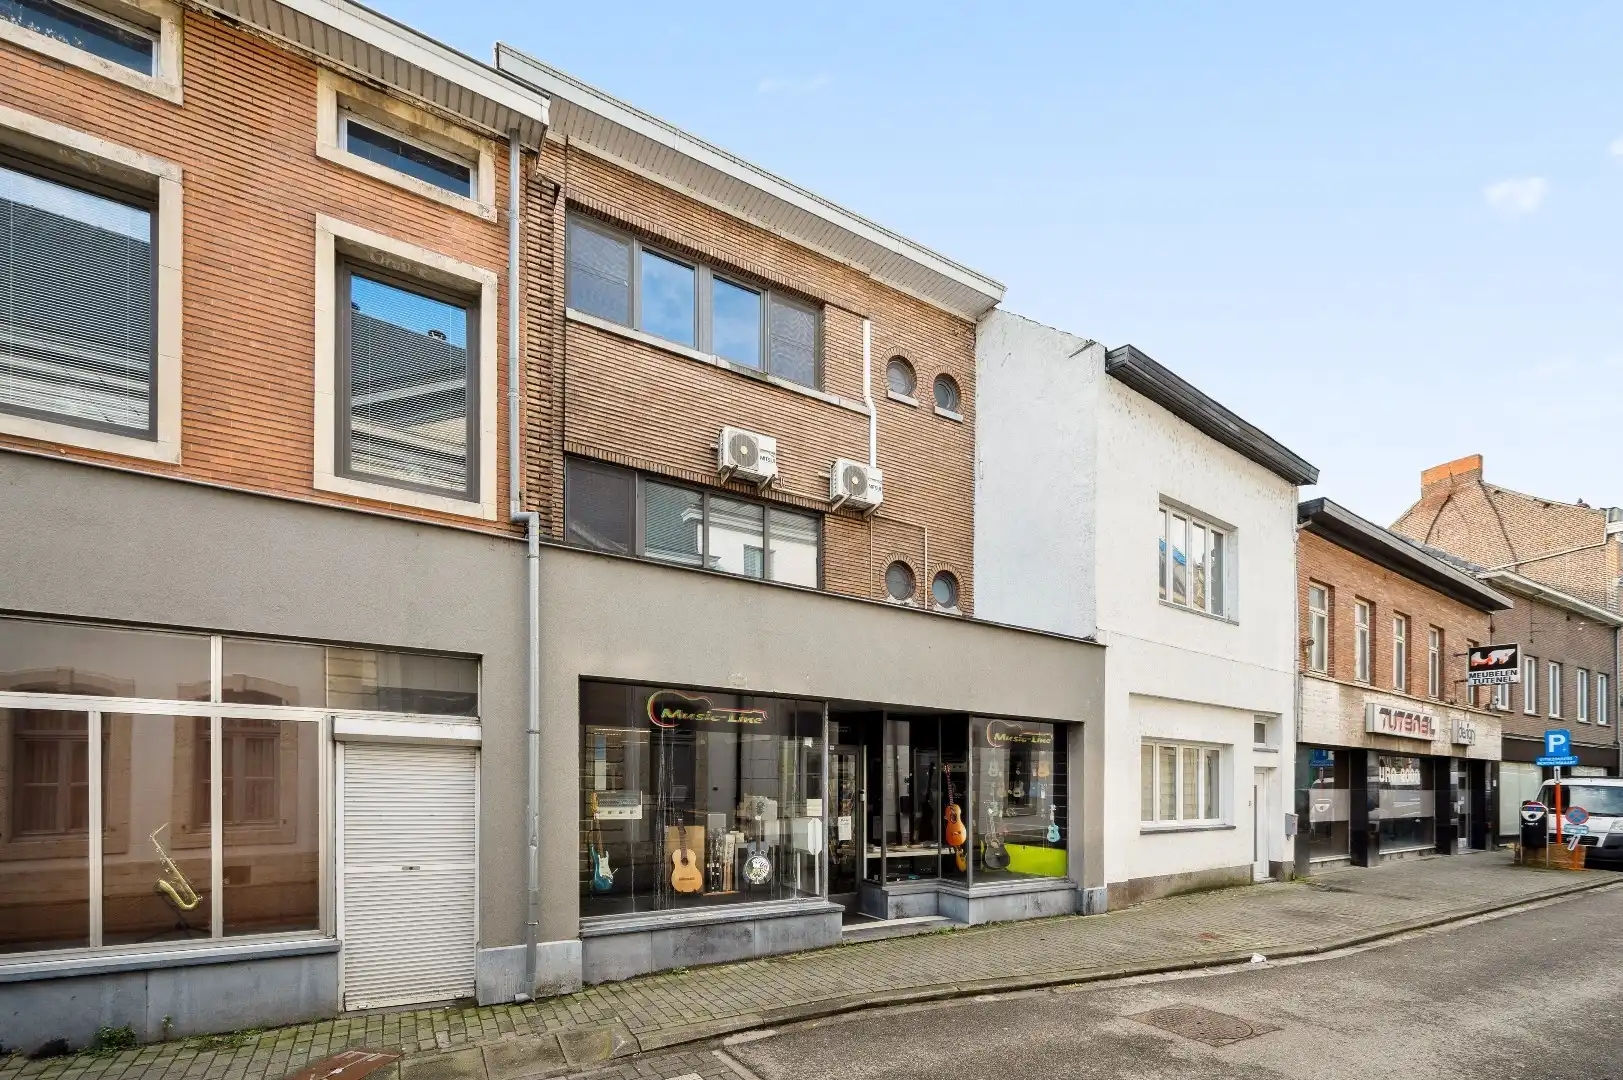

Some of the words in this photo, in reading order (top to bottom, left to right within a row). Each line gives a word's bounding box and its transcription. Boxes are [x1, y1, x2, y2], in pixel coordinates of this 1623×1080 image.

[1468, 669, 1518, 679] MEUBELEN
[1472, 676, 1514, 685] TUTENEL
[660, 708, 763, 723] Music-Line
[1379, 707, 1436, 737] TUTENEL
[1548, 734, 1566, 753] P
